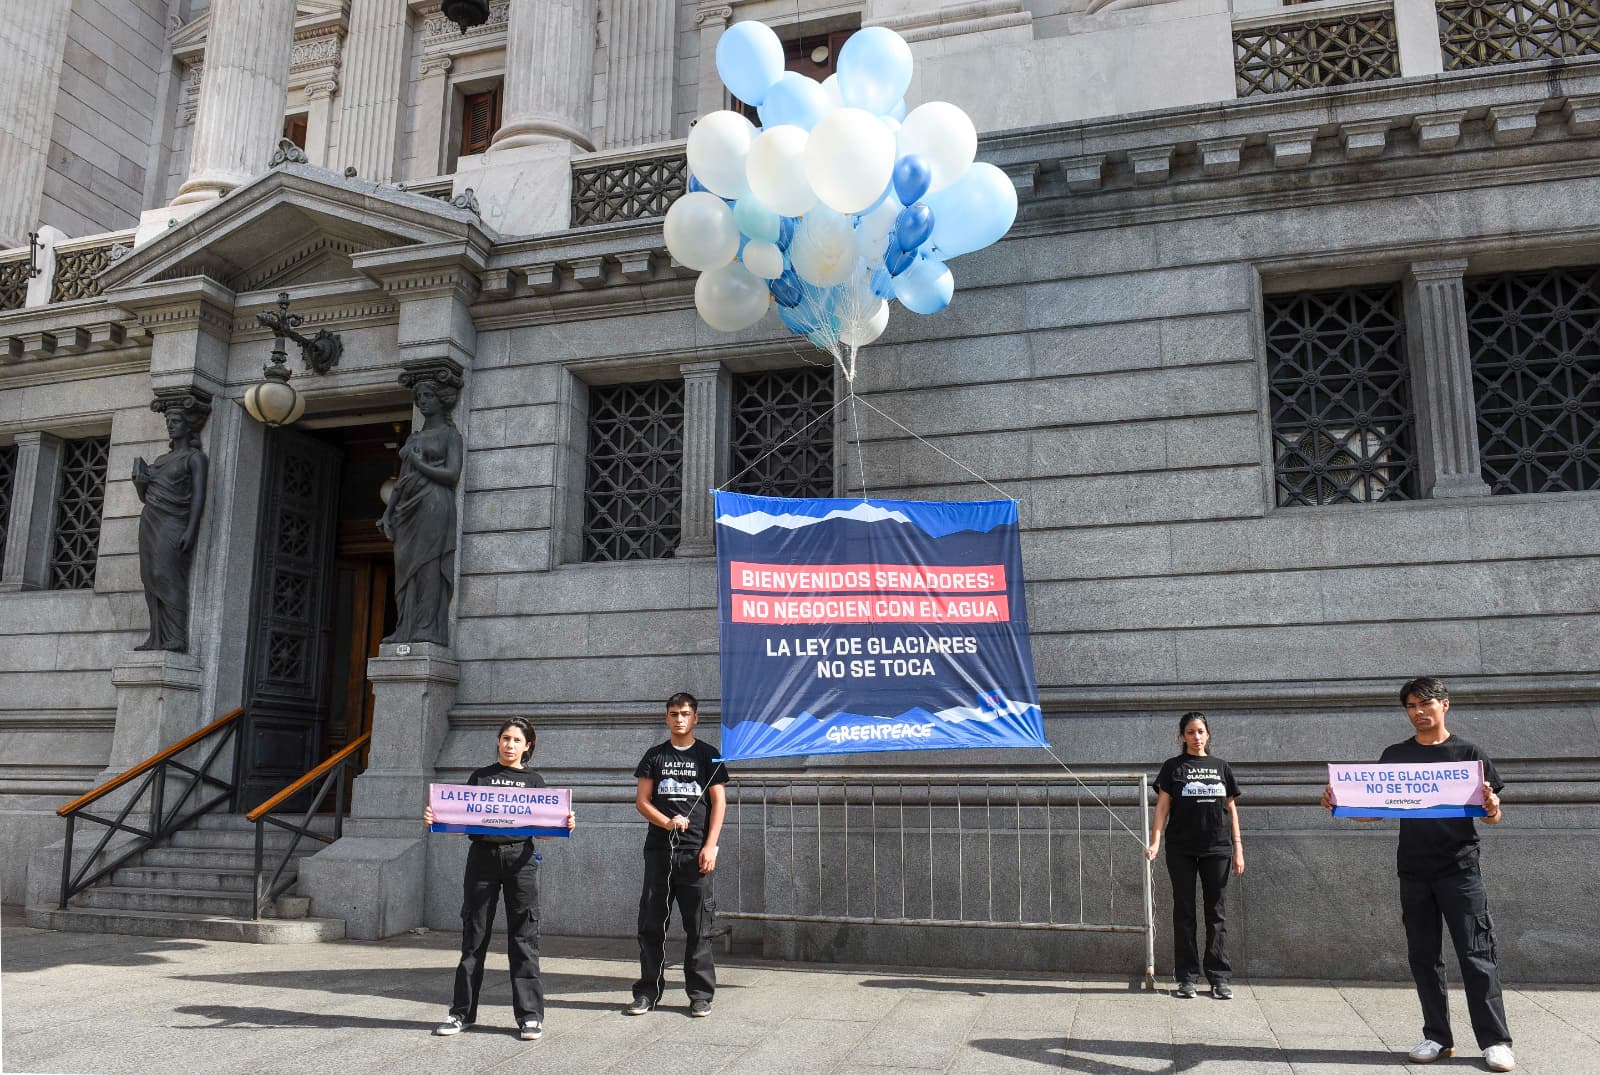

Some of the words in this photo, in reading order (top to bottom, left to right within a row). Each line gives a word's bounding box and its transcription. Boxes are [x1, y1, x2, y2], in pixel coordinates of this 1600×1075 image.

[742, 570, 870, 588] BIENVENIDOS
[876, 572, 994, 589] SENADORES:
[743, 600, 768, 618] NO
[774, 601, 870, 618] NEGOCIEN
[876, 600, 914, 617] CON
[920, 601, 942, 617] EL
[946, 601, 998, 618] AGUA
[766, 638, 790, 656] LA
[796, 638, 830, 656] LEY
[836, 638, 862, 656] DE
[867, 636, 977, 654] GLACIARES
[818, 660, 845, 678] NO
[850, 660, 876, 678] SE
[880, 659, 936, 677] TOCA
[826, 723, 936, 743] GREENPEACE
[1338, 772, 1352, 782] LA
[1354, 772, 1375, 781] LEY
[1379, 771, 1394, 781] DE
[1398, 769, 1469, 781] GLACIARES
[1366, 784, 1383, 793] NO
[1387, 784, 1402, 793] SE
[1405, 782, 1439, 793] TOCA
[441, 791, 454, 800] LA
[458, 791, 477, 801] LEY
[480, 793, 494, 802] DE
[498, 794, 559, 804] GLACIARES
[467, 804, 482, 813] NO
[485, 804, 499, 813] SE
[502, 805, 532, 815] TOCA
